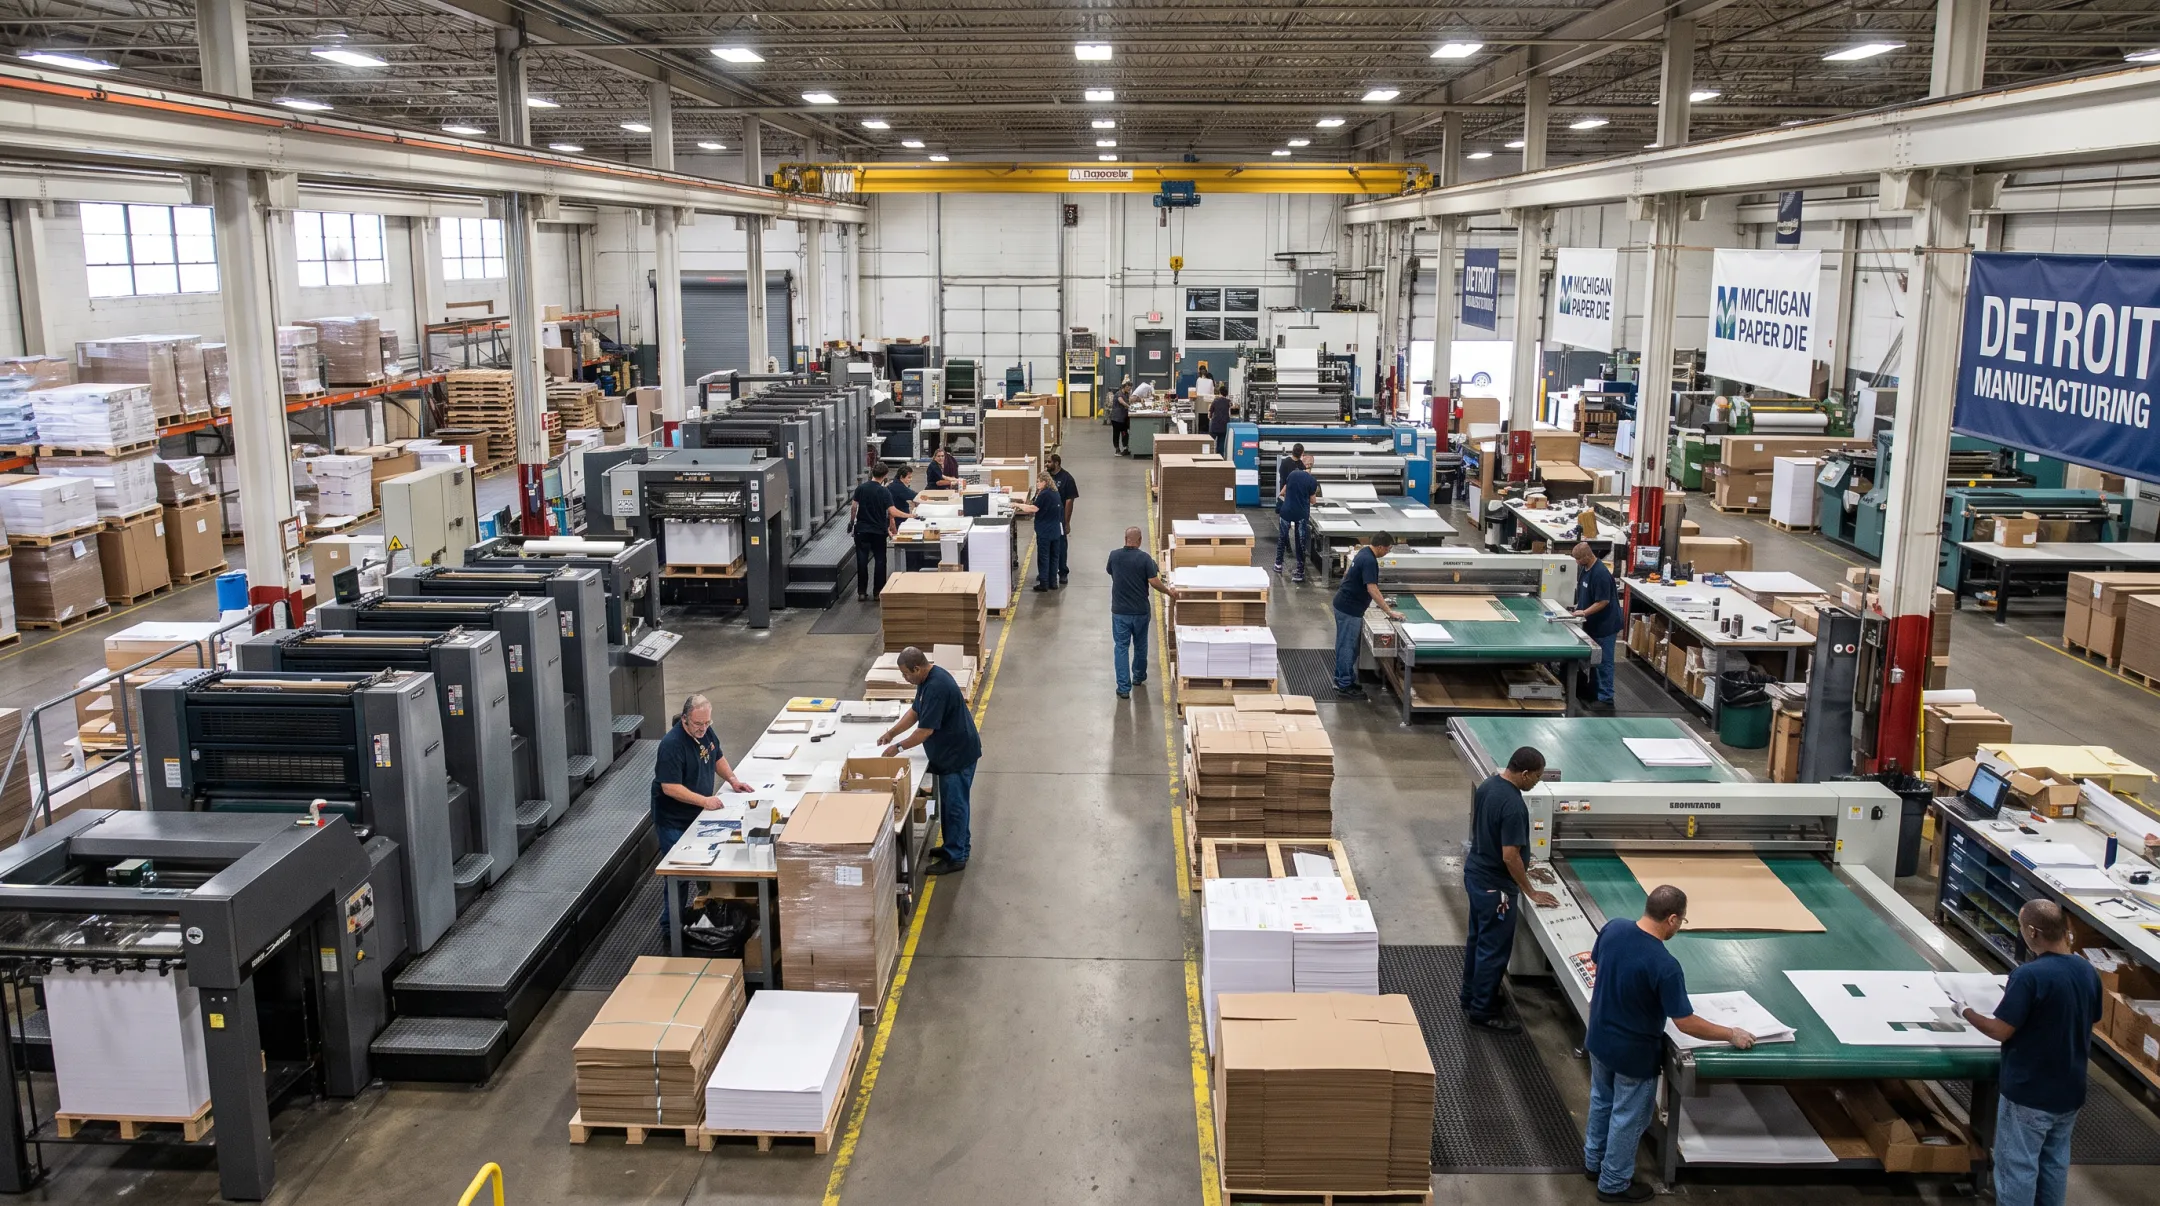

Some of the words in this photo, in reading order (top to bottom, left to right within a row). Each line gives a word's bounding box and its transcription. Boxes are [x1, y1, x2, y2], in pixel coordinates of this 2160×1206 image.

[1465, 265, 1496, 294] DETROIT
[1573, 276, 1612, 296] MICHIGAN
[1571, 298, 1595, 318] PAPER
[1596, 301, 1610, 321] DIE
[1740, 287, 1811, 318] MICHIGAN
[1738, 318, 1779, 348] PAPER
[1782, 323, 1808, 352] DIE
[1979, 295, 2160, 380] DETROIT
[1973, 366, 2150, 429] MANUFACTURING
